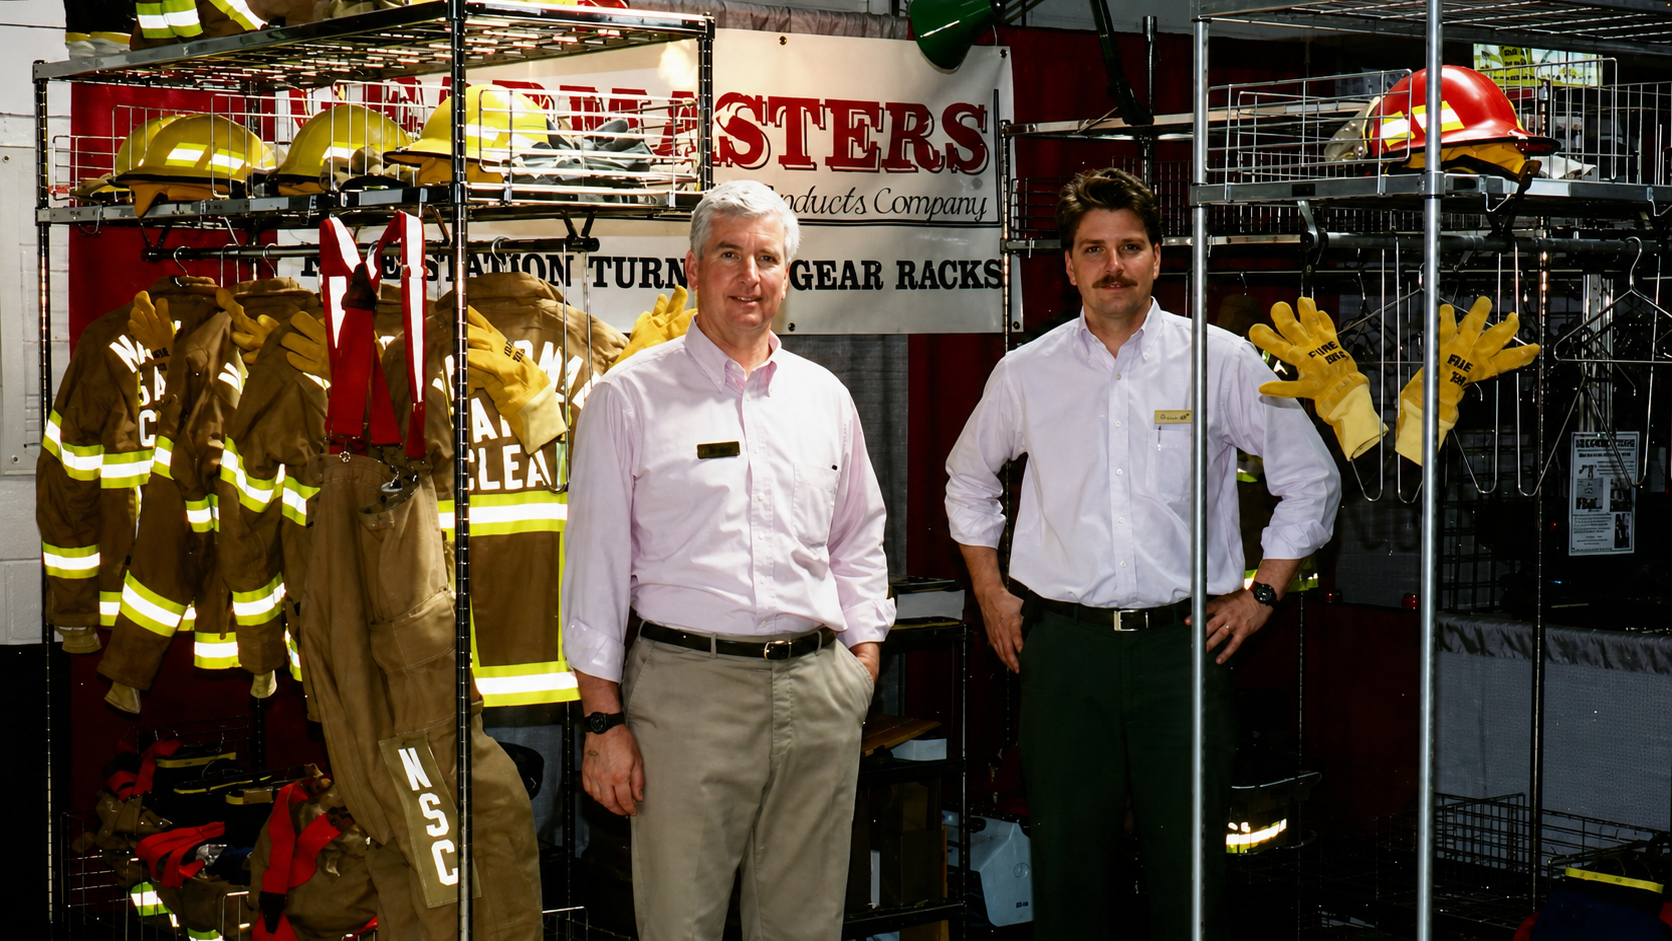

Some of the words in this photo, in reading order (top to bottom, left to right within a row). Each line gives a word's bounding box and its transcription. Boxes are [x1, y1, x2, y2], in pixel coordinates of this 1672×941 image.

[288, 76, 988, 174] EMASTERS
[767, 183, 866, 215] oducts
[873, 187, 988, 222] Company
[789, 259, 884, 291] GEAR
[895, 259, 1003, 291] RACKS
[398, 747, 459, 886] NSC
